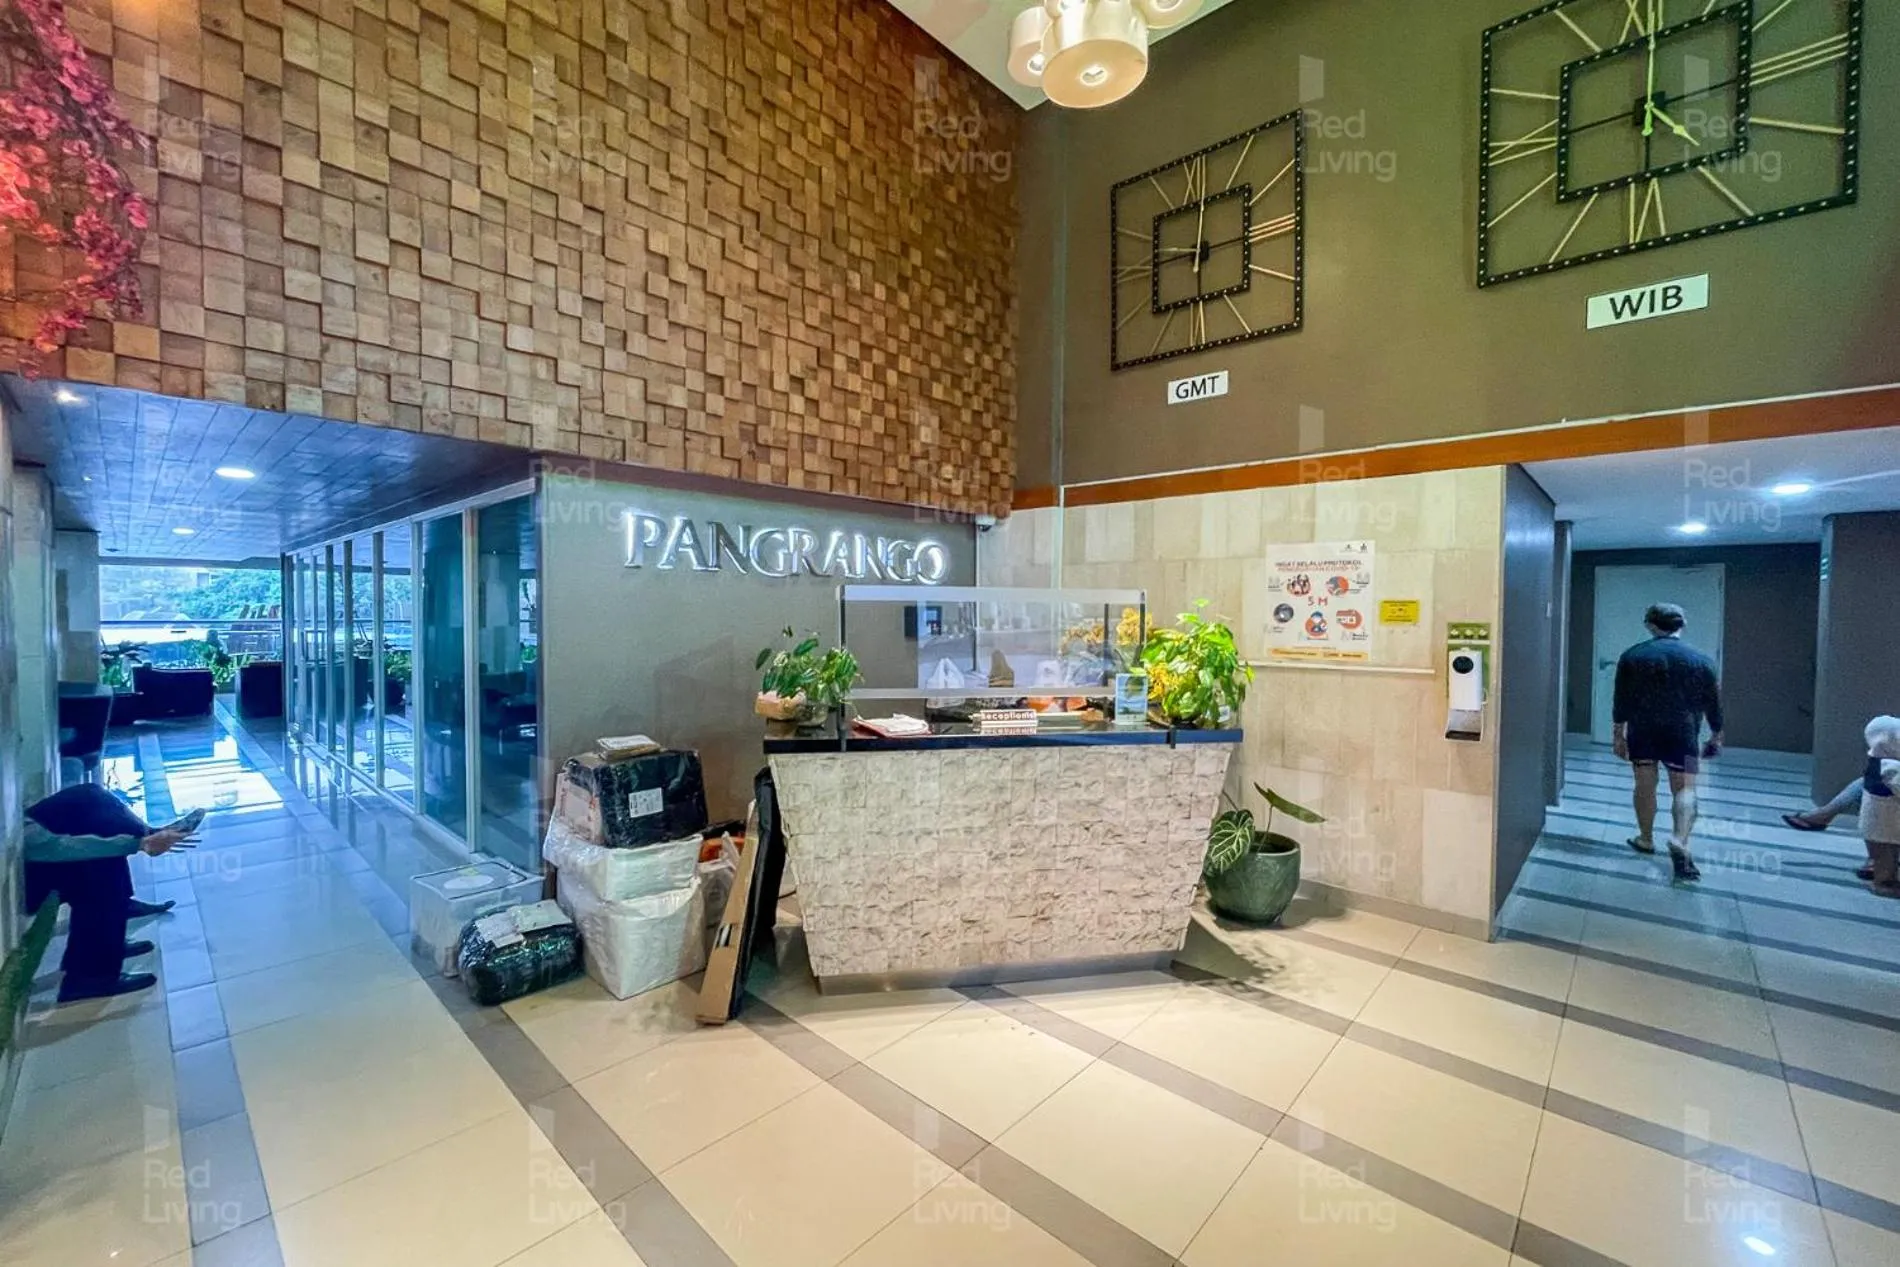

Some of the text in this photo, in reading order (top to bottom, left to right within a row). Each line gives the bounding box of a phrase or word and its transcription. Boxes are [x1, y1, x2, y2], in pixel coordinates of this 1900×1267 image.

[1609, 284, 1684, 320] WIB
[1175, 375, 1220, 399] GMT
[622, 507, 947, 585] PANGRANGO
